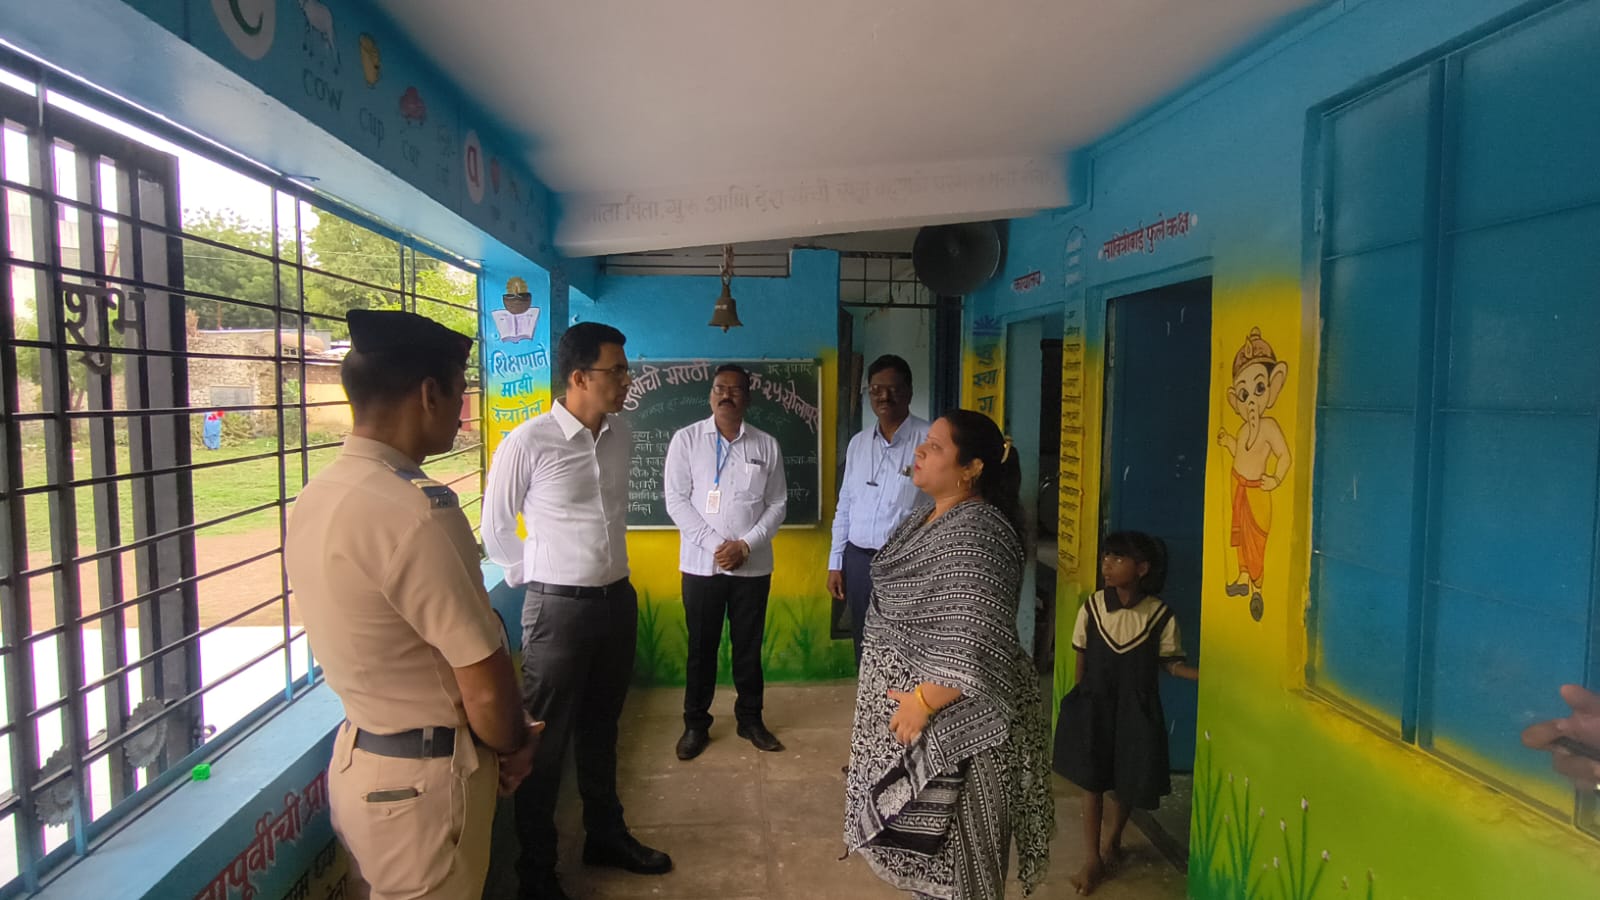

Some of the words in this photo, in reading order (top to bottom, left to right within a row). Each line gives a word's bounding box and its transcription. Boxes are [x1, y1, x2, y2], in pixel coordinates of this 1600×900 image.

[491, 343, 549, 377] शिक्षणाने
[500, 373, 533, 398] माझी
[622, 364, 662, 411] ुलांची
[662, 359, 711, 385] मराठी
